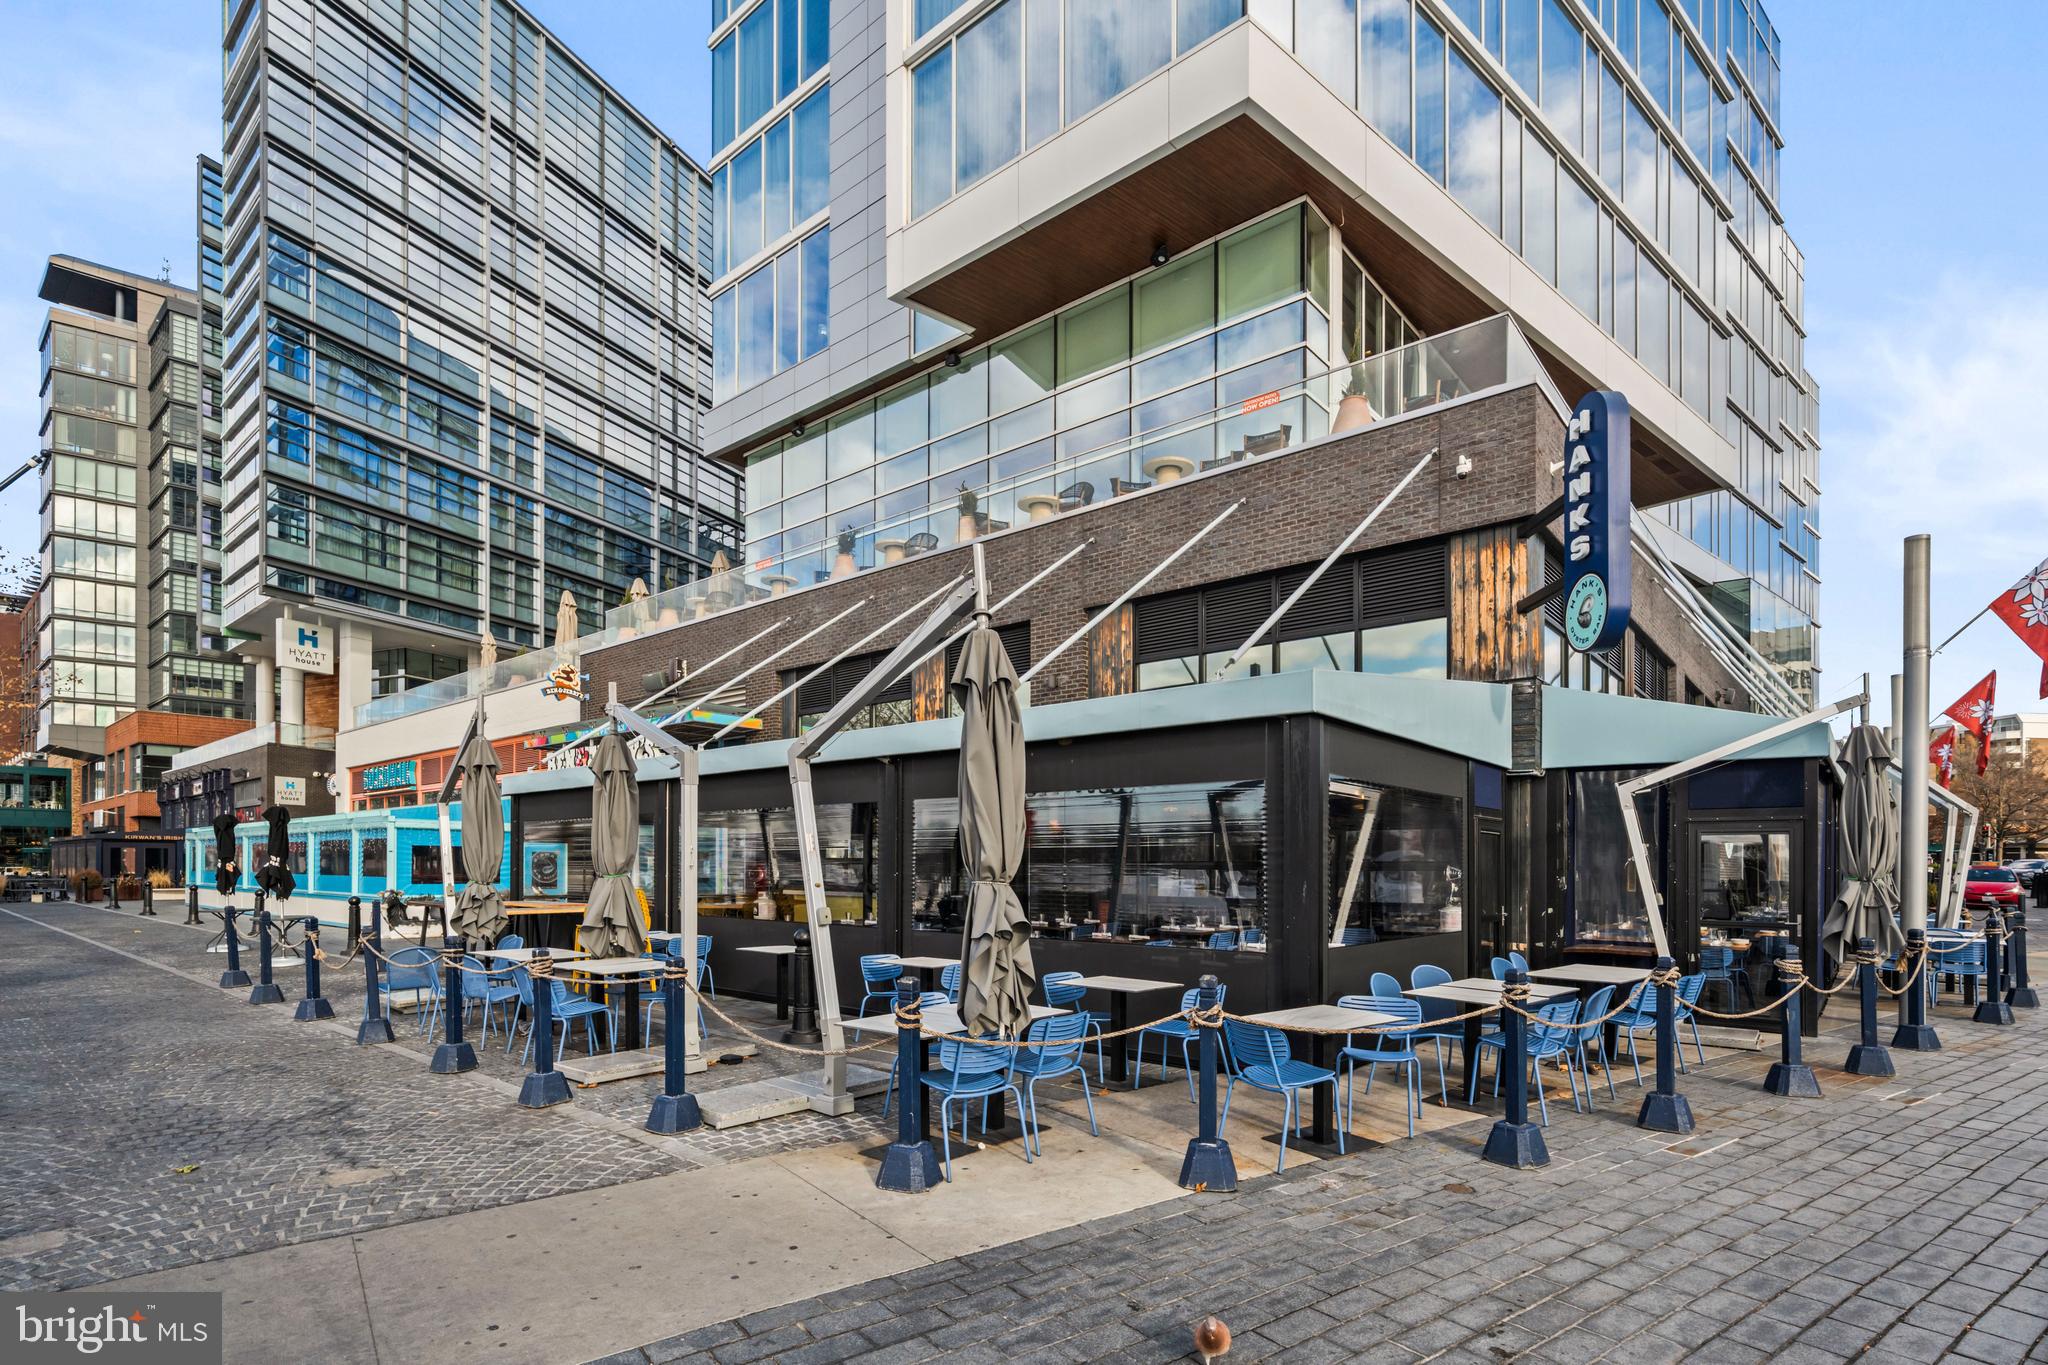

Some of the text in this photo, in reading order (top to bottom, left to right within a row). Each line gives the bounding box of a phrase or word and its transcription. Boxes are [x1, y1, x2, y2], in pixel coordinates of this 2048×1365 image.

[1241, 403, 1257, 414] NOW
[1568, 408, 1591, 562] HANKS
[1570, 579, 1603, 609] HANK'S
[1570, 614, 1602, 644] OYSTER BAR
[288, 648, 327, 661] HYATT
[295, 656, 321, 666] house
